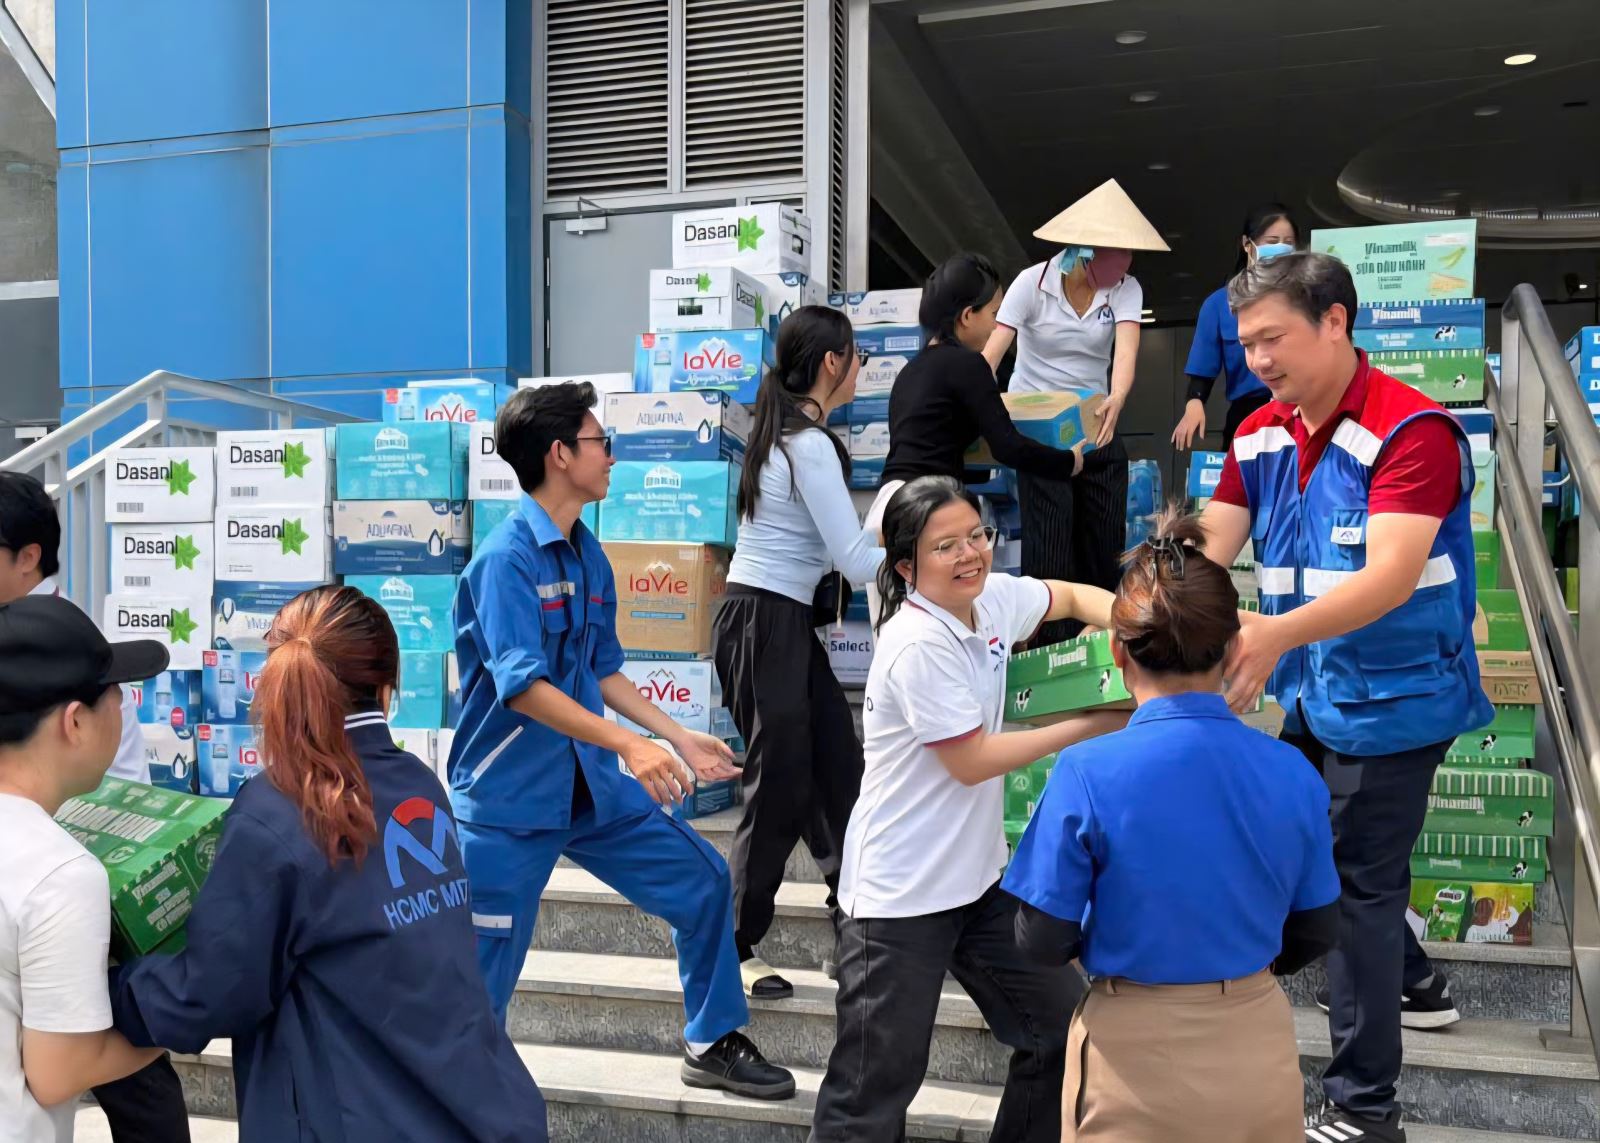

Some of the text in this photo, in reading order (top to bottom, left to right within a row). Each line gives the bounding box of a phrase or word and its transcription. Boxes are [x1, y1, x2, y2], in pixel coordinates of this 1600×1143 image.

[683, 217, 741, 242] Dasani
[683, 347, 742, 370] laVie
[230, 443, 287, 463] Dasani
[116, 460, 173, 480] Dasani
[227, 518, 285, 538] Dasani
[124, 534, 178, 554] Dasani
[629, 570, 688, 594] laVie
[118, 607, 174, 628] Dasani
[830, 640, 871, 652] Select
[632, 679, 691, 703] aVie
[383, 889, 440, 930] HCMC
